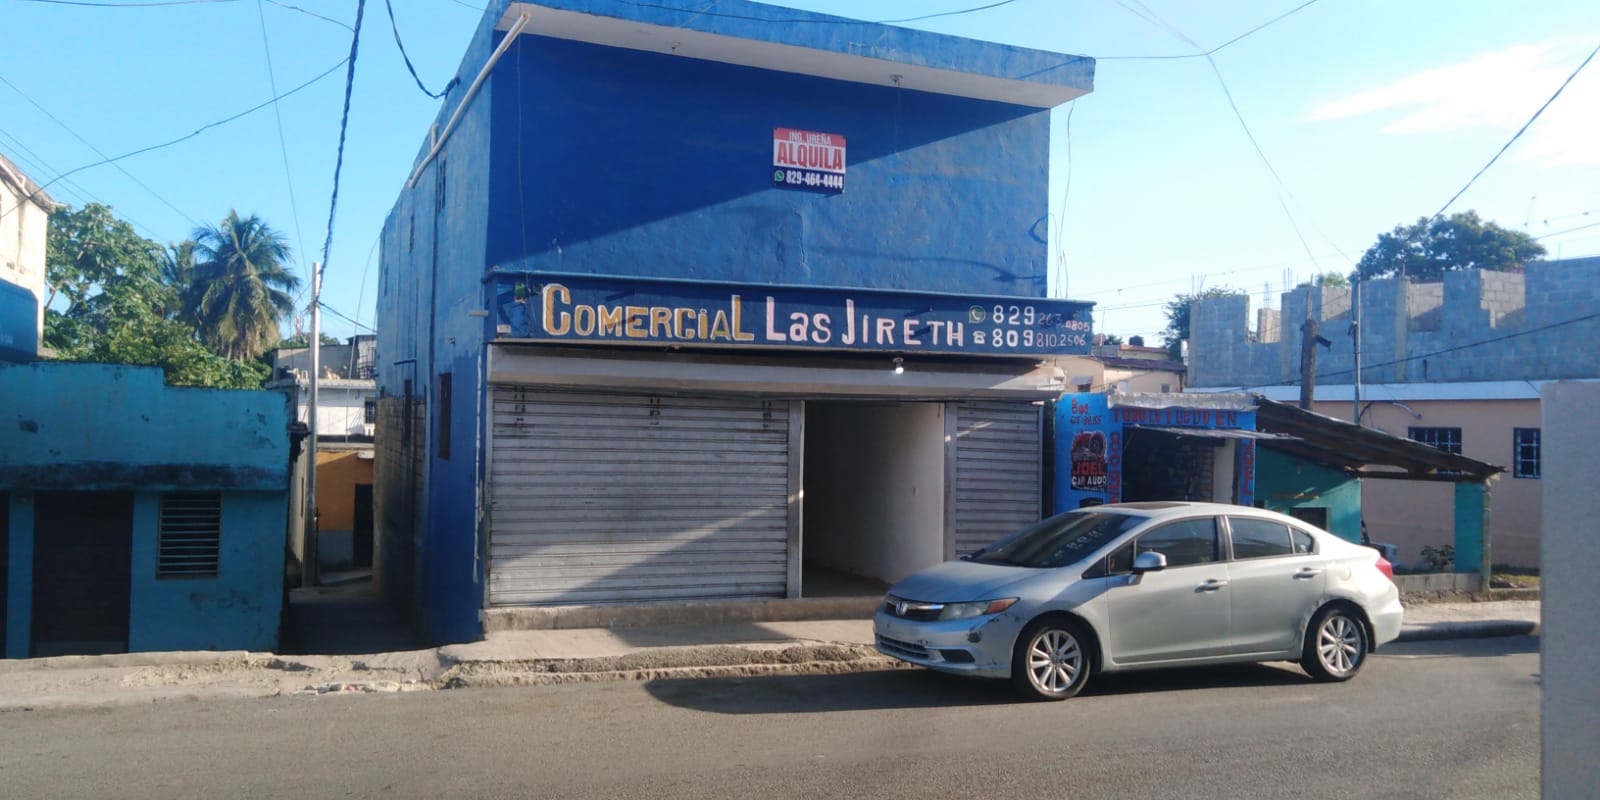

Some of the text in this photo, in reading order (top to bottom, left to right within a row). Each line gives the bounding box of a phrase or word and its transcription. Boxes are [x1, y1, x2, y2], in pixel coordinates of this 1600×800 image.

[776, 142, 843, 171] ALQUILA
[786, 170, 844, 190] 829-464-4444
[992, 304, 1035, 326] 829
[991, 328, 1034, 348] 809
[1072, 461, 1105, 475] JOEL
